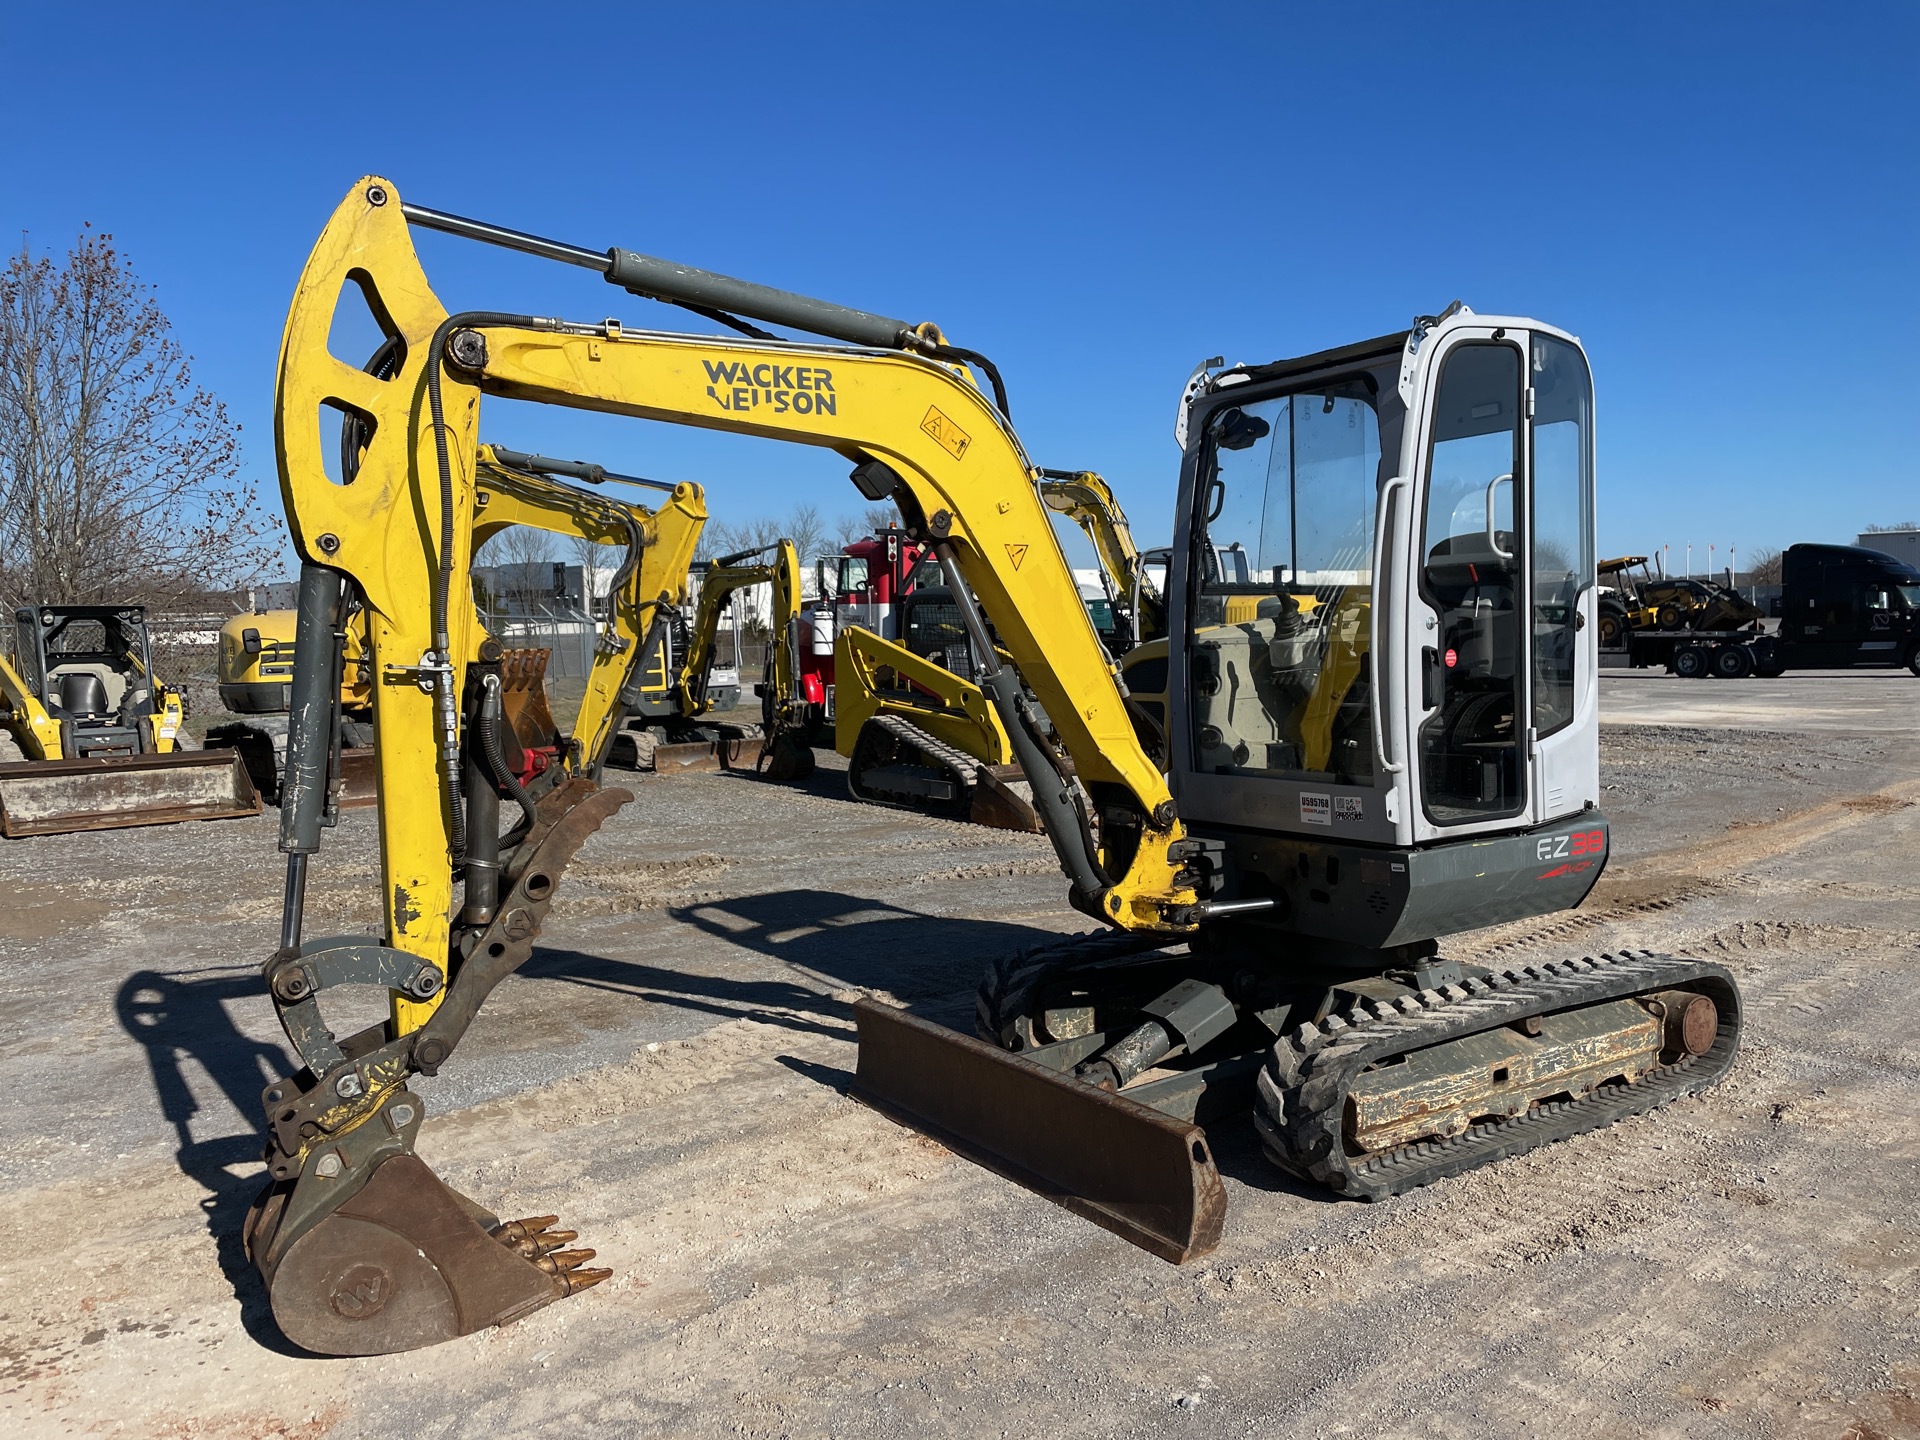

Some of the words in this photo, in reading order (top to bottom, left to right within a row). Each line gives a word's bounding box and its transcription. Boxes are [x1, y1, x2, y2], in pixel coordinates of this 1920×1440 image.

[701, 359, 836, 392] WACKER
[1301, 796, 1329, 808] U595768
[1537, 830, 1604, 860] EZ38
